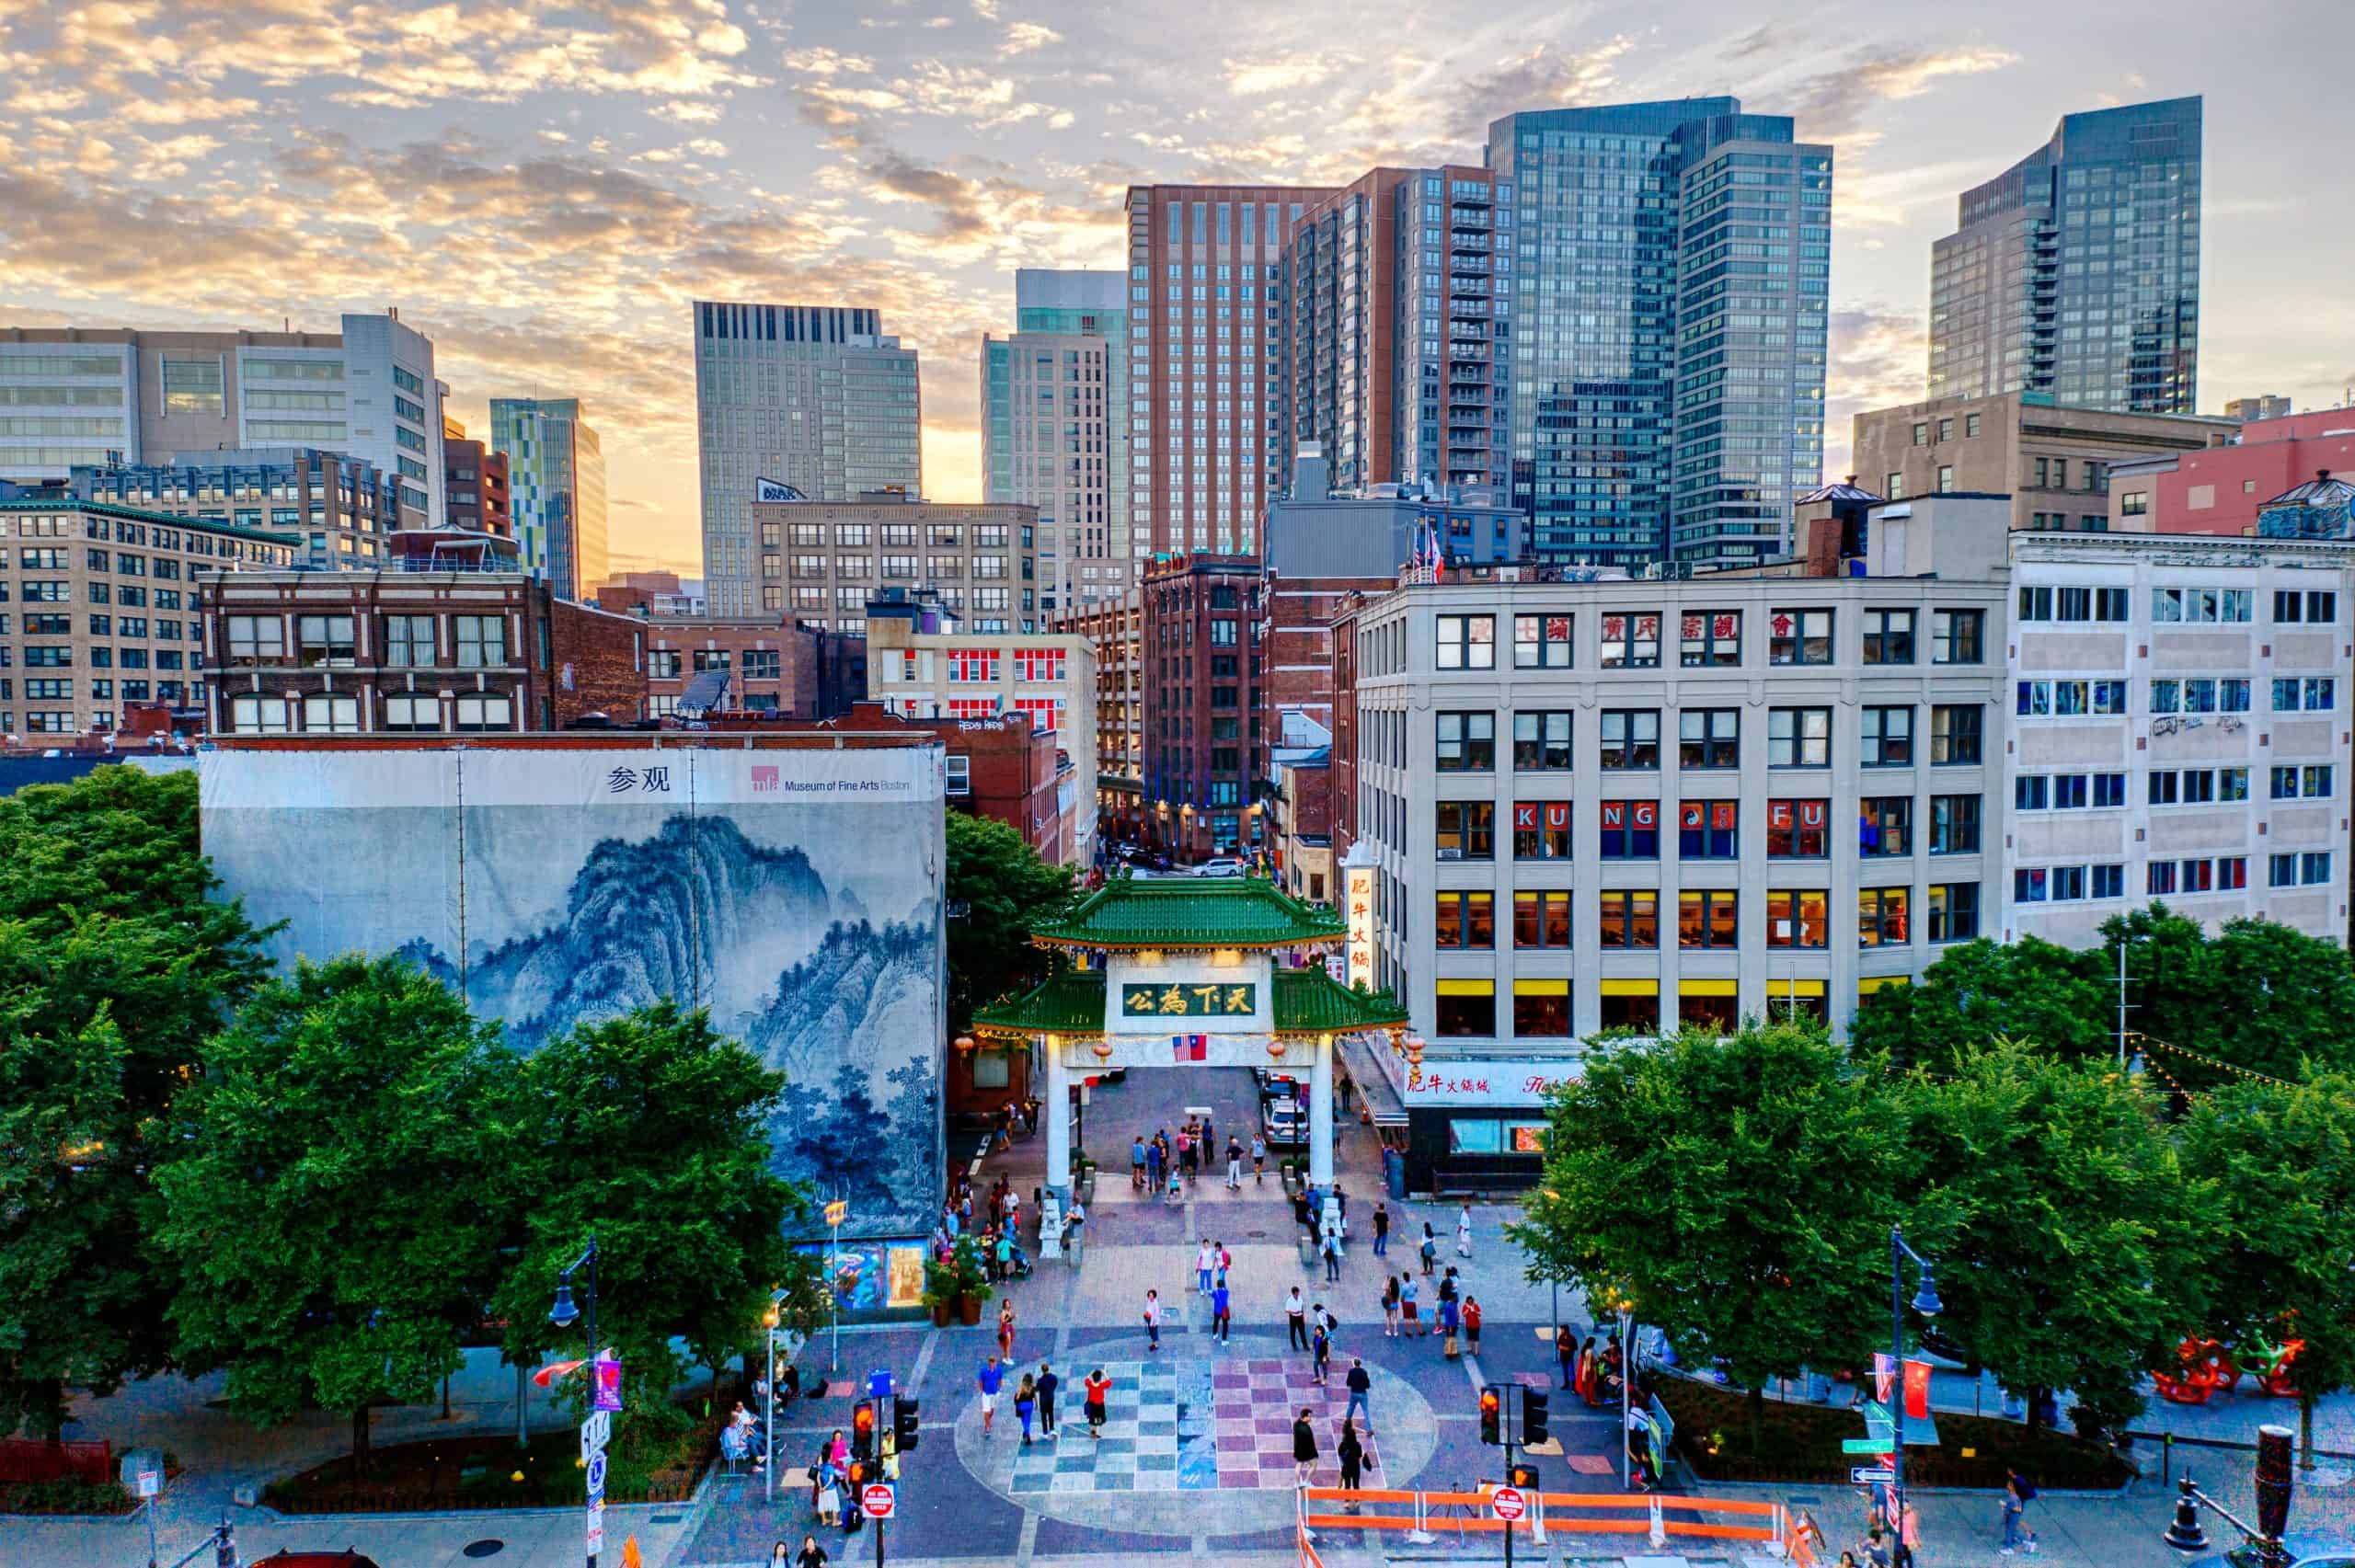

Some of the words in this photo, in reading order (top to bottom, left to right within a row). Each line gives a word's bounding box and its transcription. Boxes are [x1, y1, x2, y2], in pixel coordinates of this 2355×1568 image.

[607, 766, 670, 793] 参观
[785, 781, 824, 792] Museum
[827, 781, 836, 792] of
[838, 781, 857, 792] Fine
[860, 781, 879, 792] Arts
[880, 780, 910, 791] Boston
[1773, 806, 1821, 826] FU
